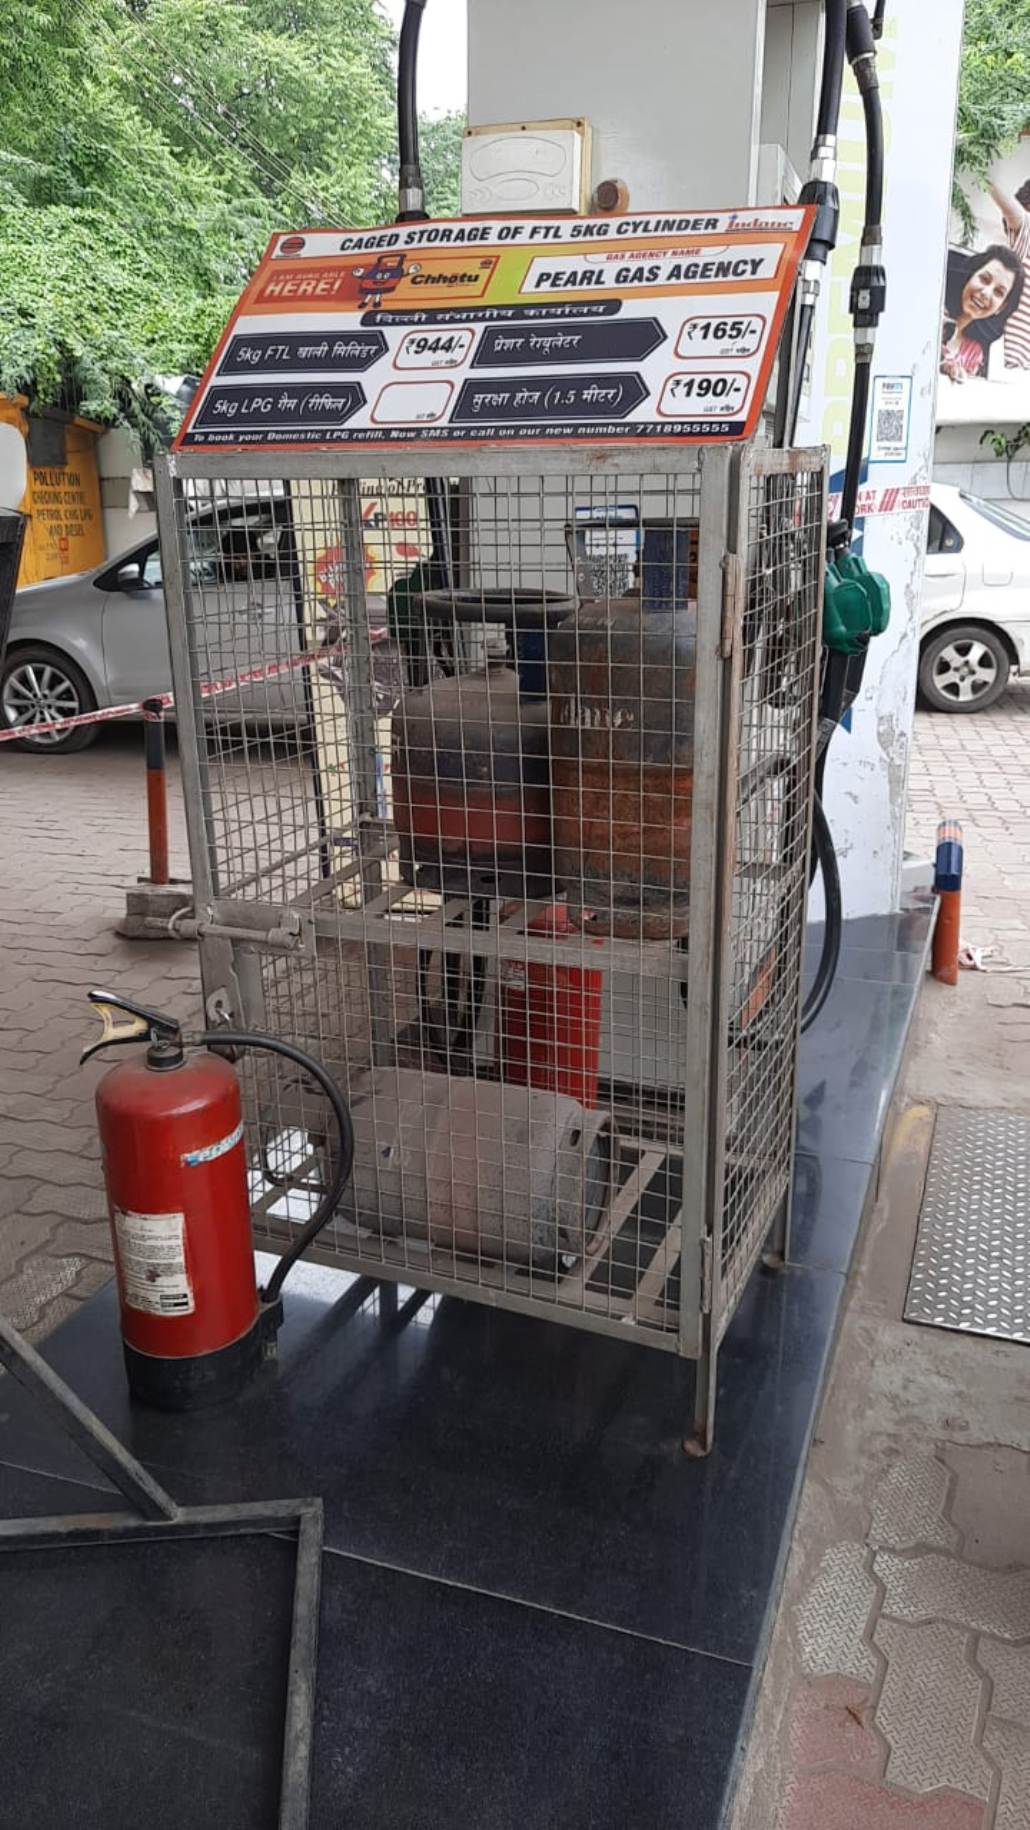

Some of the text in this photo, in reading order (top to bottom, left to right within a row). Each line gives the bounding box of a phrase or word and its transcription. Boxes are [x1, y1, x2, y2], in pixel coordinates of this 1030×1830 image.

[339, 217, 719, 252] CAGED STORAGE OF FTL 5KG CYLINDER
[606, 248, 701, 261] GAS AGENCY NAME
[411, 273, 480, 285] Chhotu
[534, 258, 765, 289] PEARL GAS AGENCY
[263, 278, 343, 297] HERE!
[687, 320, 757, 340] ₹165/-
[236, 347, 262, 365] 5kg
[264, 345, 292, 361] FTL
[297, 341, 329, 358] खाली
[405, 335, 465, 355] ₹944/-
[494, 335, 525, 353] प्रेशर
[670, 377, 741, 398] ₹190/-
[212, 399, 239, 417] 5kg
[241, 398, 273, 414] LPG
[472, 384, 623, 413] सुरक्षा होज (1.5 मीटर)
[194, 433, 205, 441] To
[208, 433, 234, 441] book
[238, 433, 263, 442] your
[267, 431, 322, 440] Domestic
[325, 430, 349, 439] LPG
[420, 428, 449, 437] SMS
[470, 428, 495, 436] call
[519, 428, 541, 436] our
[545, 427, 574, 435] new
[577, 425, 630, 434] number
[635, 423, 730, 434] 7718955555
[33, 471, 80, 486] POLLUTION
